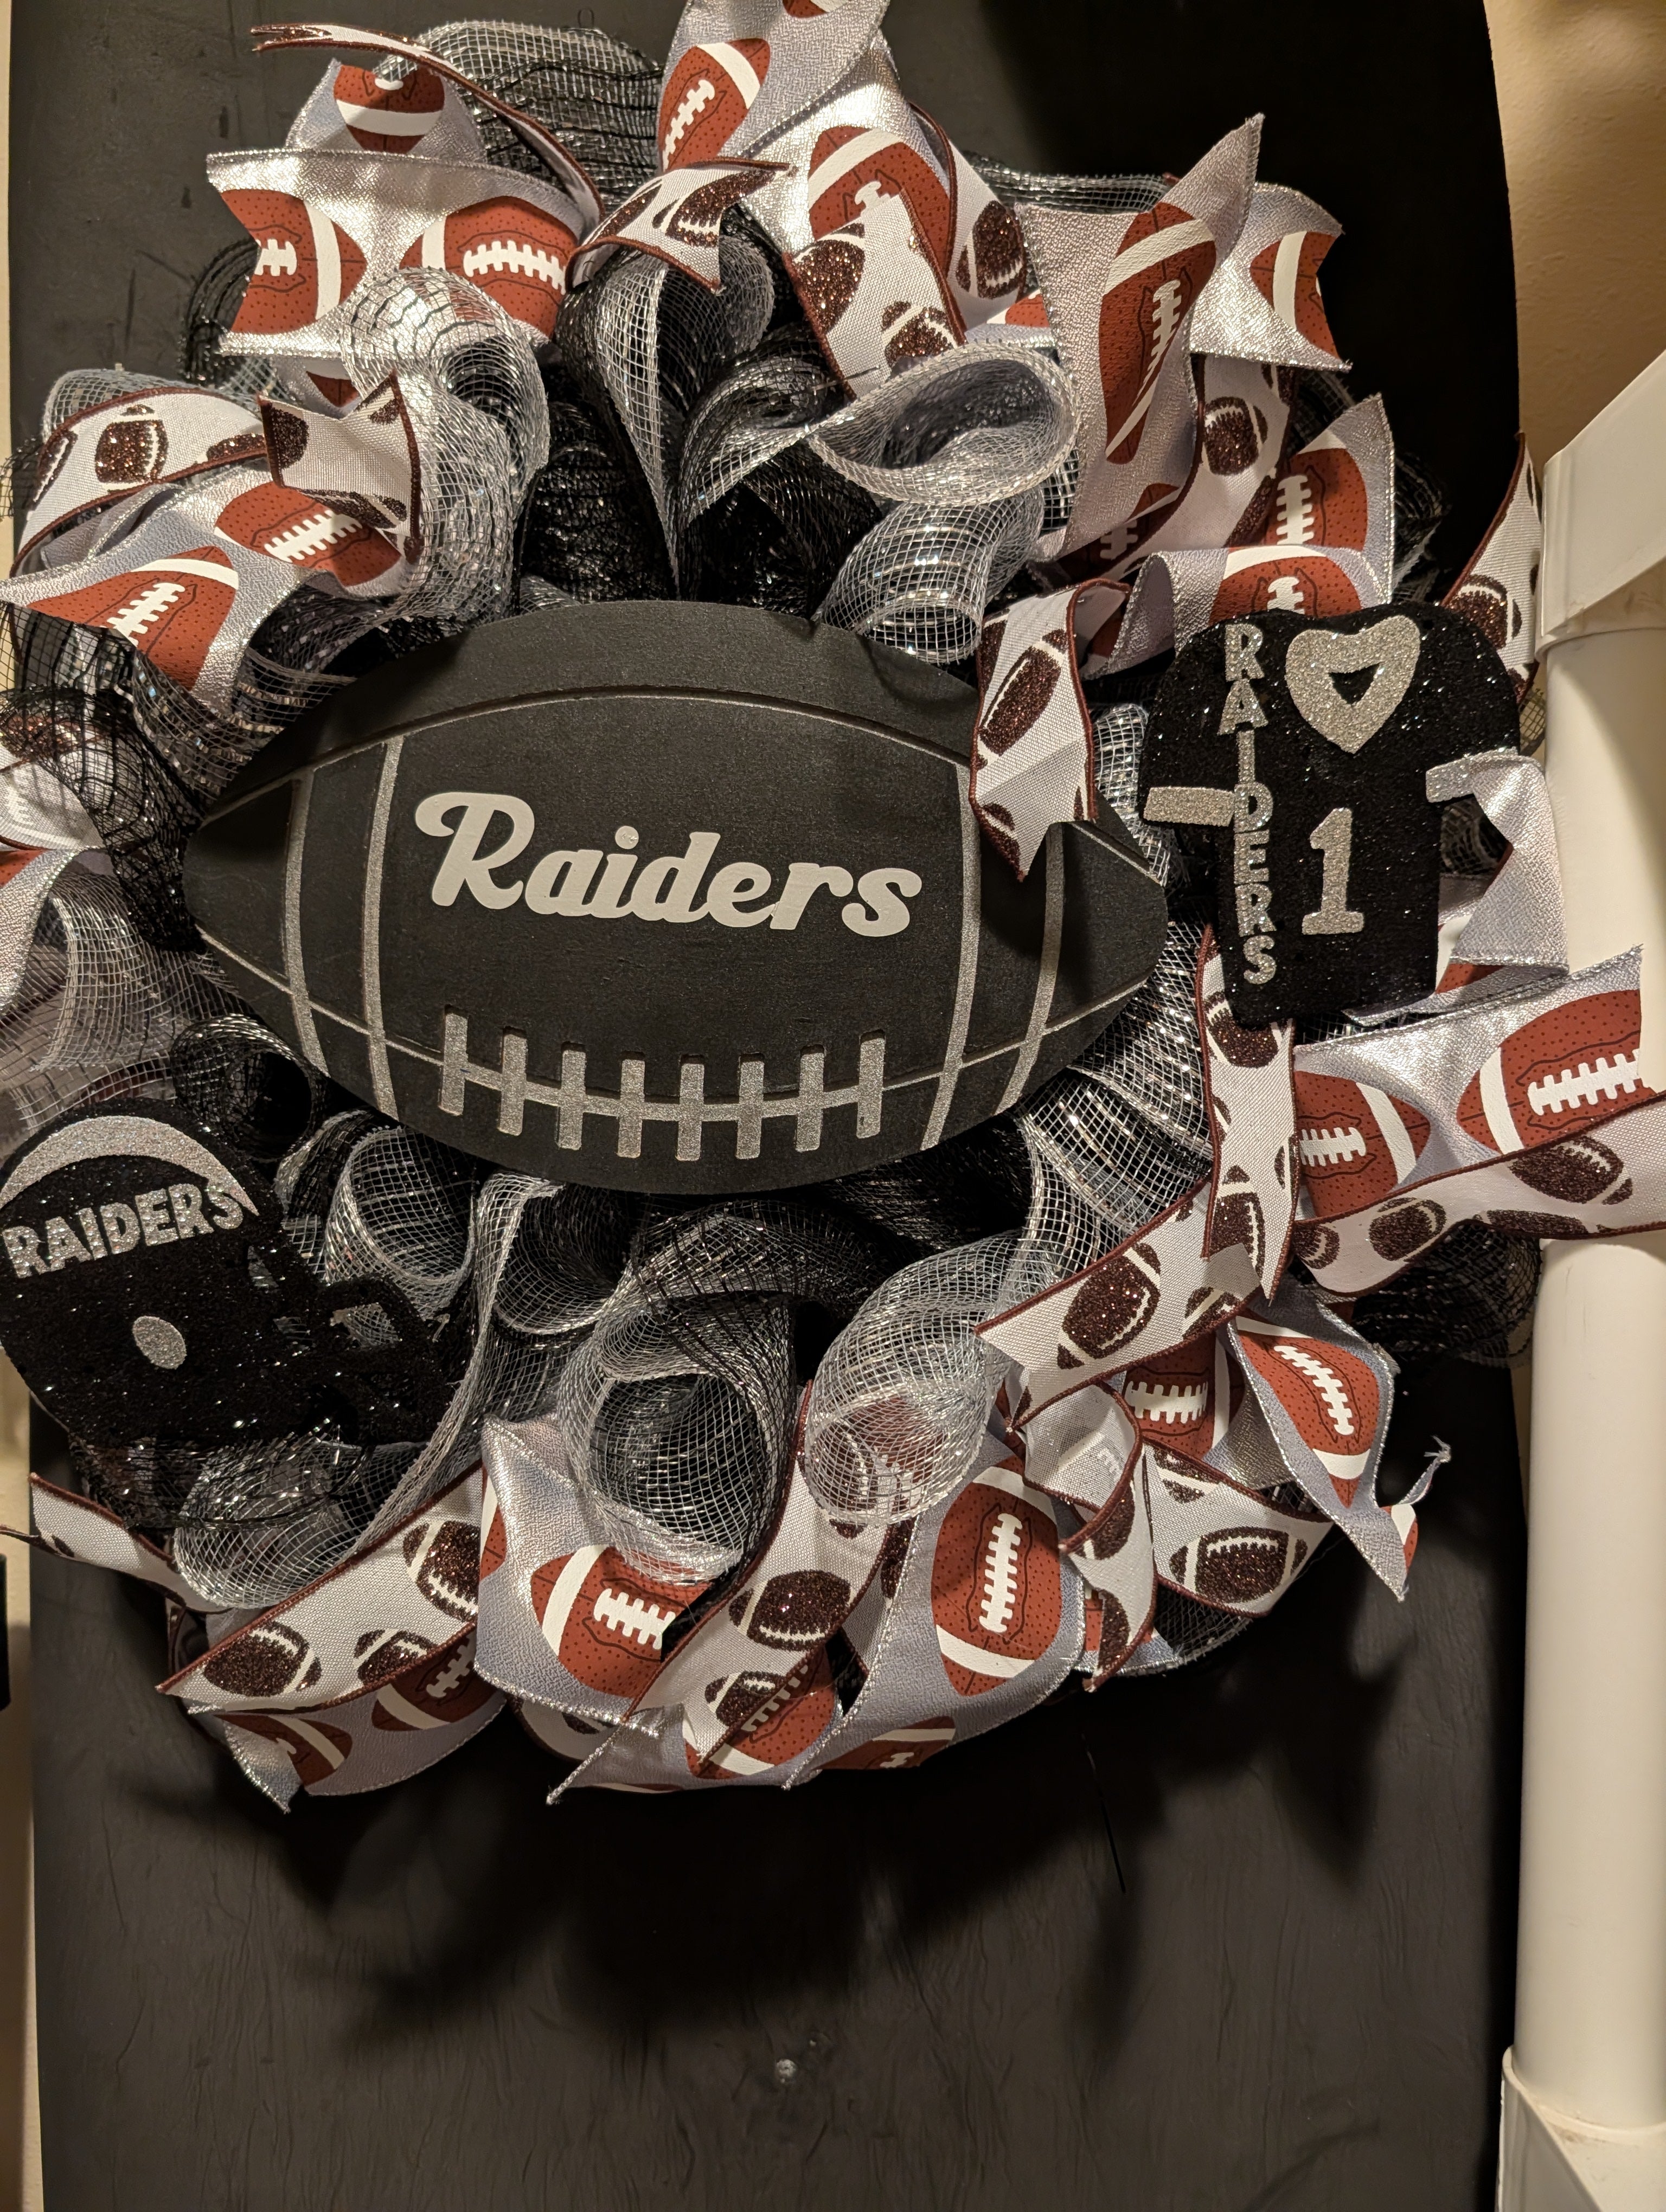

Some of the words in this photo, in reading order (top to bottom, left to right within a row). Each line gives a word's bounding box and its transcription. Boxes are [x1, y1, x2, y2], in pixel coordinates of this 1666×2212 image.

[415, 792, 922, 937] Raiders
[1217, 623, 1277, 985] RAIDERS
[1302, 807, 1364, 935] 1
[2, 1182, 244, 1278] RAIDERS
